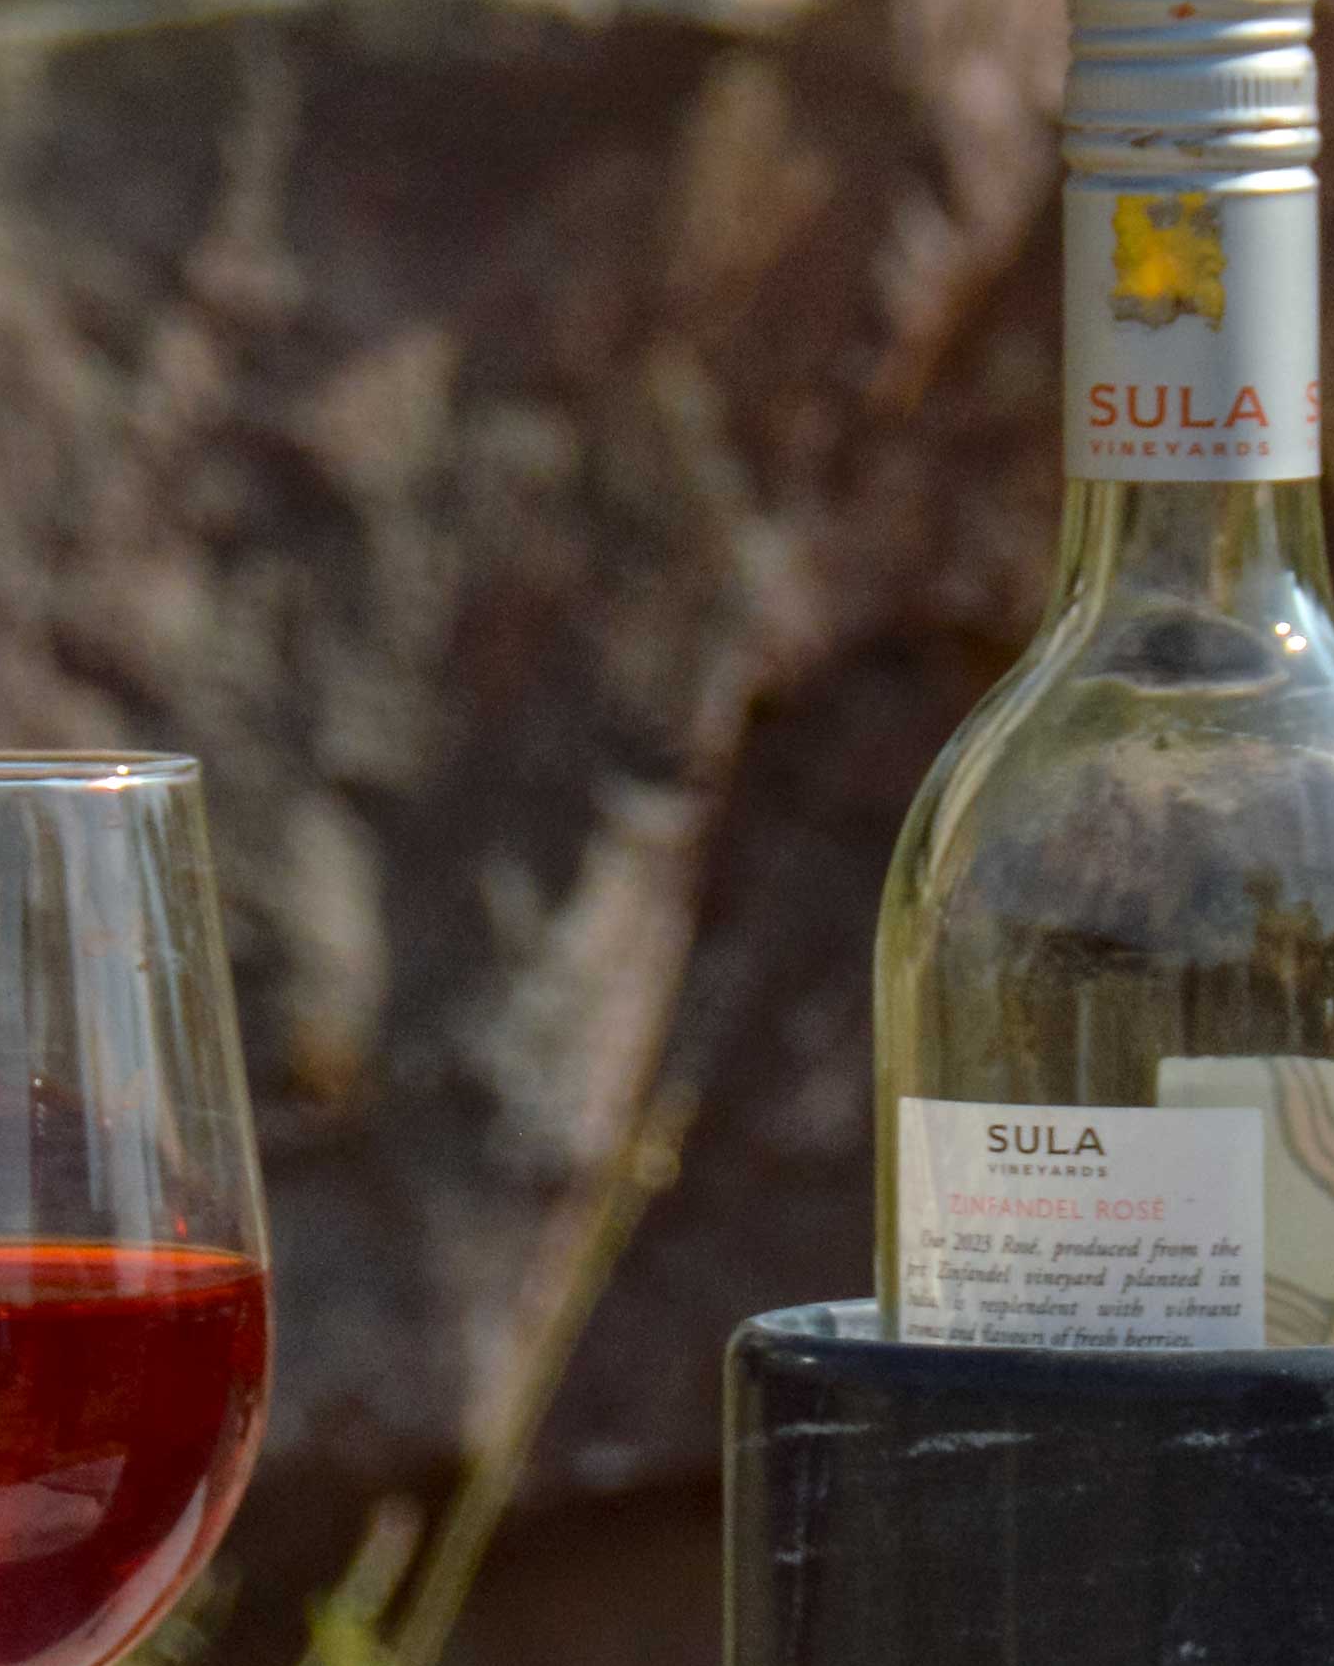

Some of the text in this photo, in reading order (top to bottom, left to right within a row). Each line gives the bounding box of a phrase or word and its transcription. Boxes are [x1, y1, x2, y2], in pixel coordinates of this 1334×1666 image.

[1089, 384, 1270, 429] SULA
[1089, 439, 1271, 458] VINEYARDS
[987, 1123, 1106, 1156] SULA
[987, 1163, 1108, 1178] VINEYARDS
[950, 1194, 1084, 1220] ZINFANDEL
[1051, 1236, 1142, 1263] produced
[1146, 1237, 1199, 1264] from
[1211, 1237, 1243, 1257] the
[1026, 1266, 1107, 1292] vineyard
[1120, 1266, 1204, 1294] planted
[1219, 1269, 1241, 1286] in
[1097, 1296, 1145, 1317] with
[1165, 1296, 1242, 1318] vibrant
